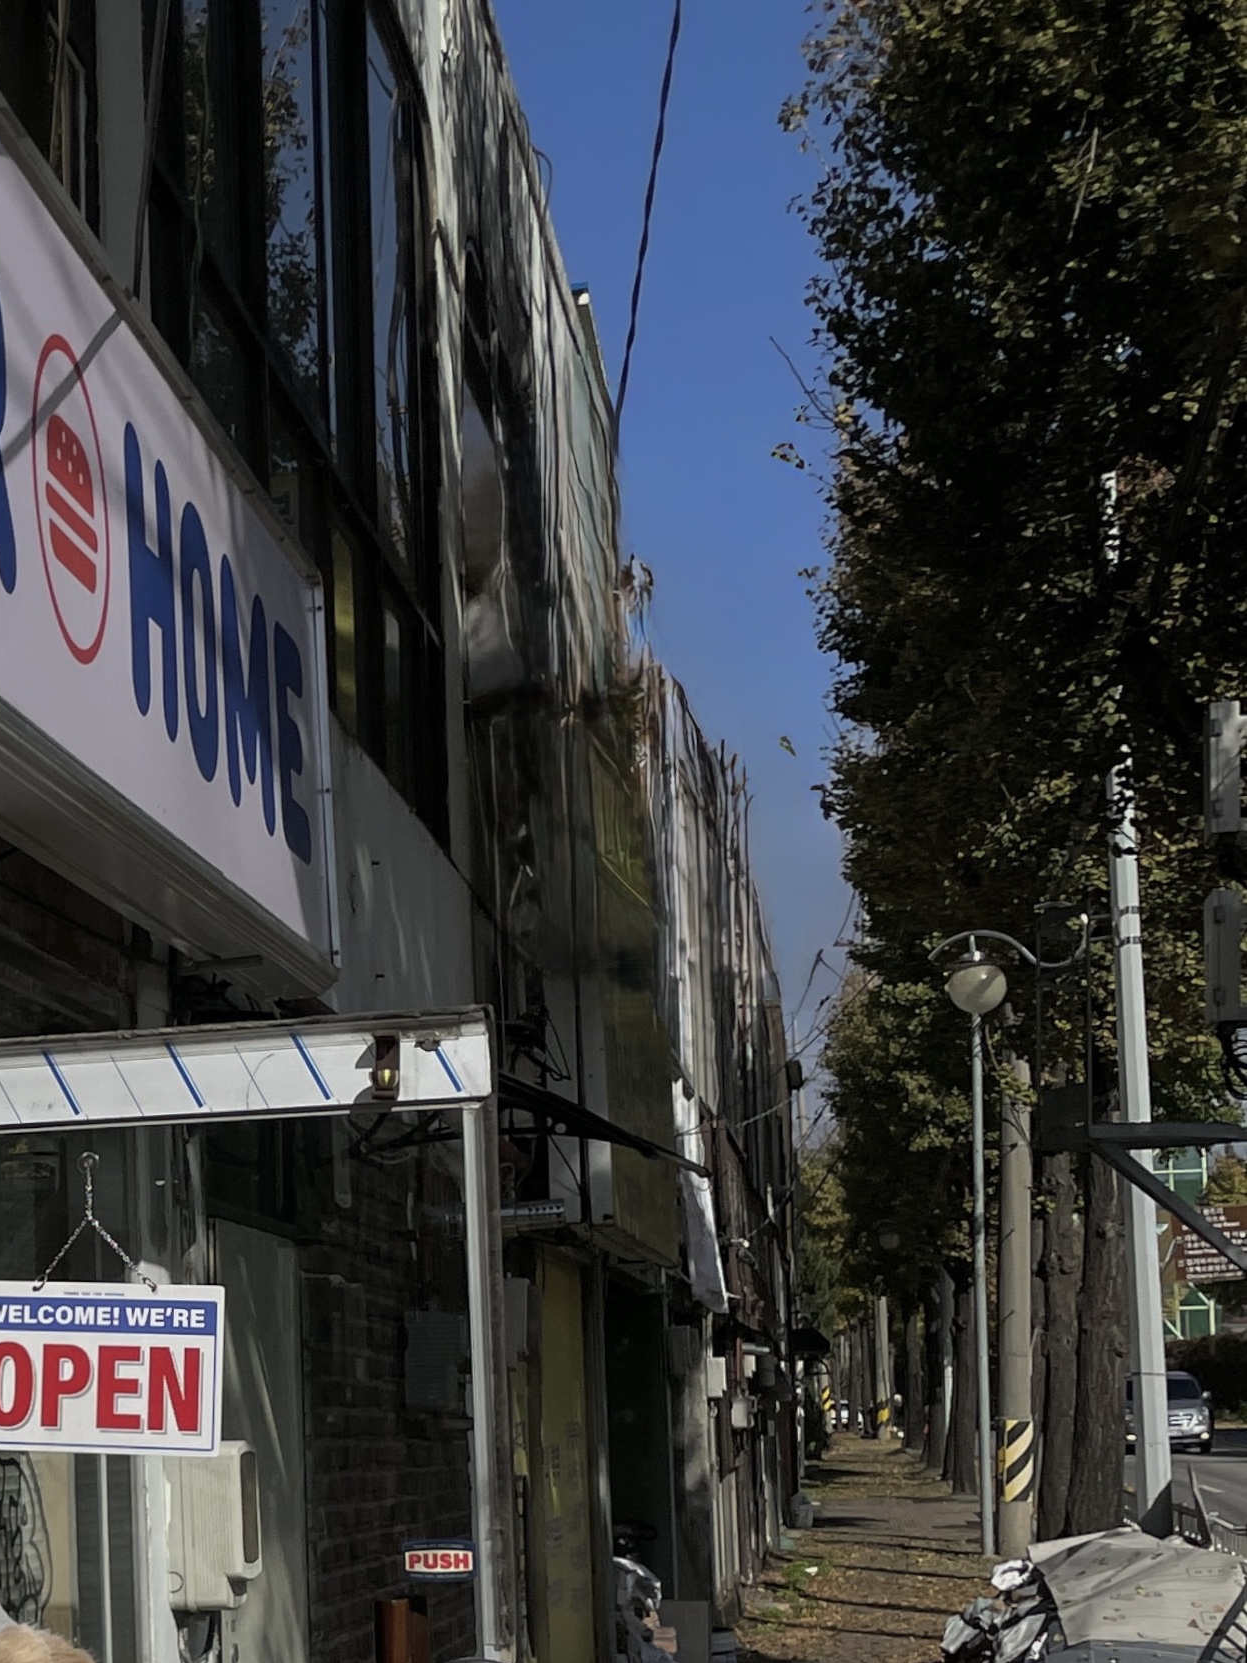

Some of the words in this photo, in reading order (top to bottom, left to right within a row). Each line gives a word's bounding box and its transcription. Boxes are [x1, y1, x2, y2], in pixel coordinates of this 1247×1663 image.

[123, 421, 312, 865] HOME
[125, 1306, 206, 1329] WE'RE
[407, 1552, 470, 1570] PUSH
